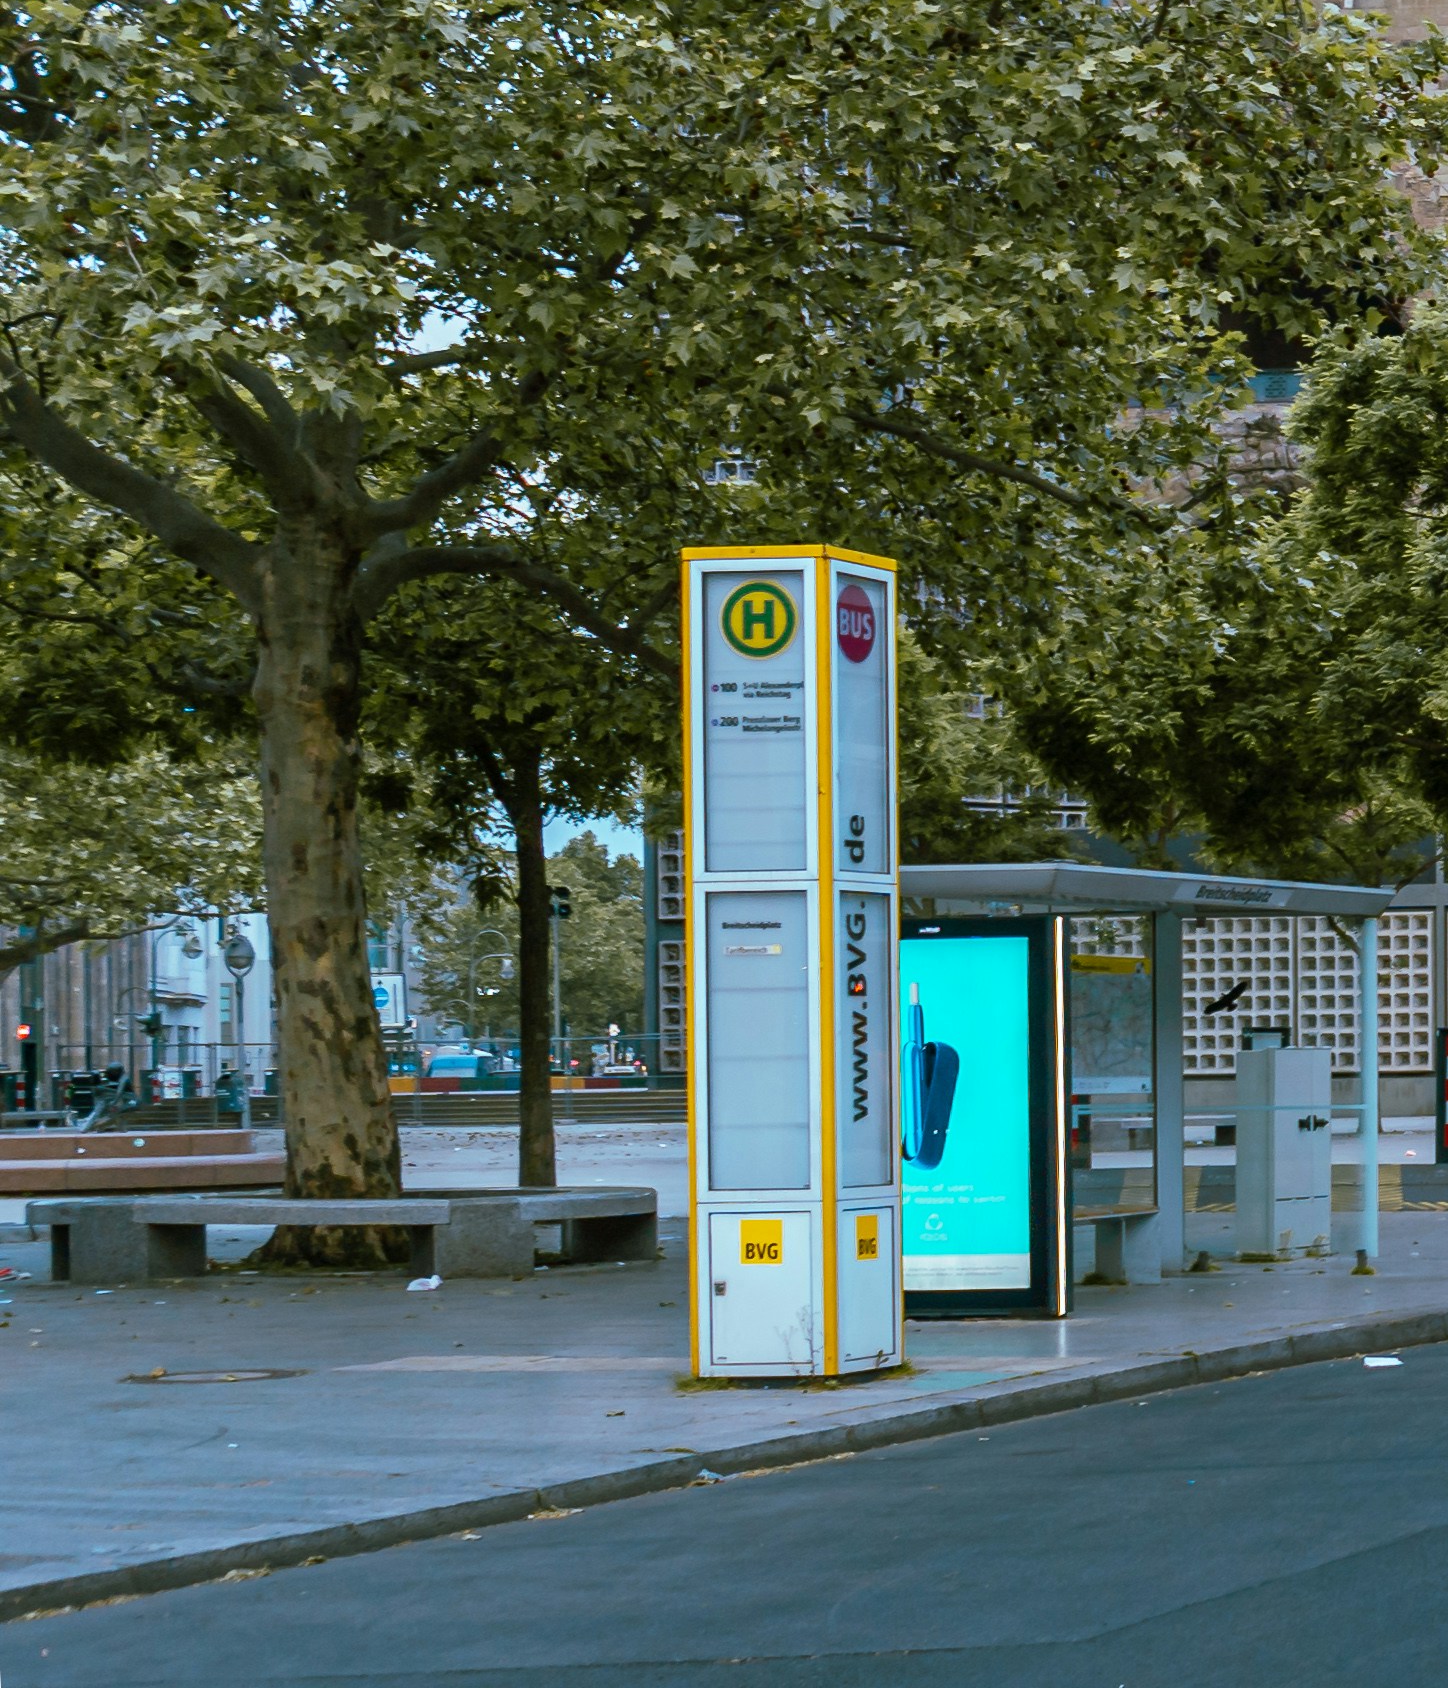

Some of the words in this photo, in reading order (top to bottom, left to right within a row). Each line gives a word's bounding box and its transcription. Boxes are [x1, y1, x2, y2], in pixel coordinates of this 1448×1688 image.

[742, 599, 775, 641] H
[839, 608, 872, 640] BUS
[720, 716, 739, 727] 200
[745, 1242, 779, 1260] BVG
[858, 1237, 877, 1256] BVG
